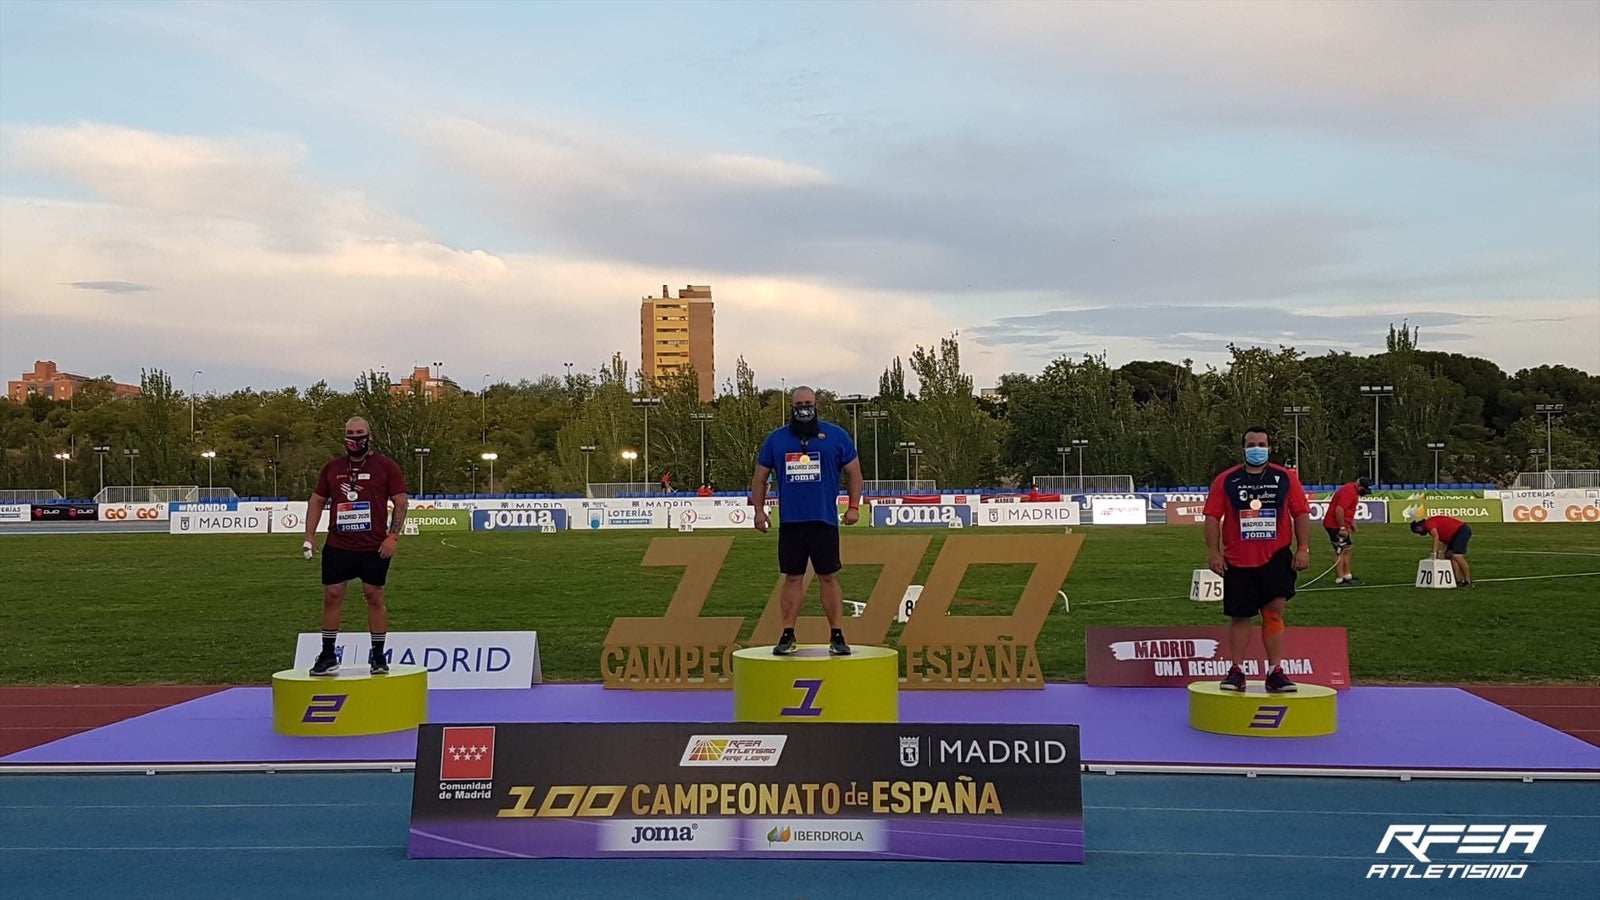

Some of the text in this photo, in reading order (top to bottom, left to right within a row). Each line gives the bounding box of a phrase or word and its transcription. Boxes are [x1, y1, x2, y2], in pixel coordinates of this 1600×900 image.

[105, 508, 128, 519] GO
[136, 507, 160, 519] GO
[186, 503, 228, 512] MONDO
[608, 508, 653, 517] LOTERÍAS
[1008, 508, 1070, 520] MADRID
[1427, 508, 1489, 517] IBERDROLA
[1513, 500, 1555, 521] GO fit
[200, 517, 259, 528] MADRID
[1420, 570, 1452, 585] 70 70
[1204, 581, 1222, 598] 75
[1134, 641, 1196, 658] MADRID
[906, 635, 1044, 683] ESPAÑA
[1155, 660, 1183, 676] UNA
[780, 679, 824, 716] 1
[301, 694, 349, 723] 2
[1249, 706, 1289, 729] 3
[728, 740, 762, 748] RFEA
[940, 740, 1067, 764] MADRID
[440, 782, 492, 790] Comunidad
[439, 790, 491, 800] de Madrid
[496, 775, 1003, 818] 100 CAMPEONATO de ESPAÑA
[794, 831, 863, 842] IBERDROLA
